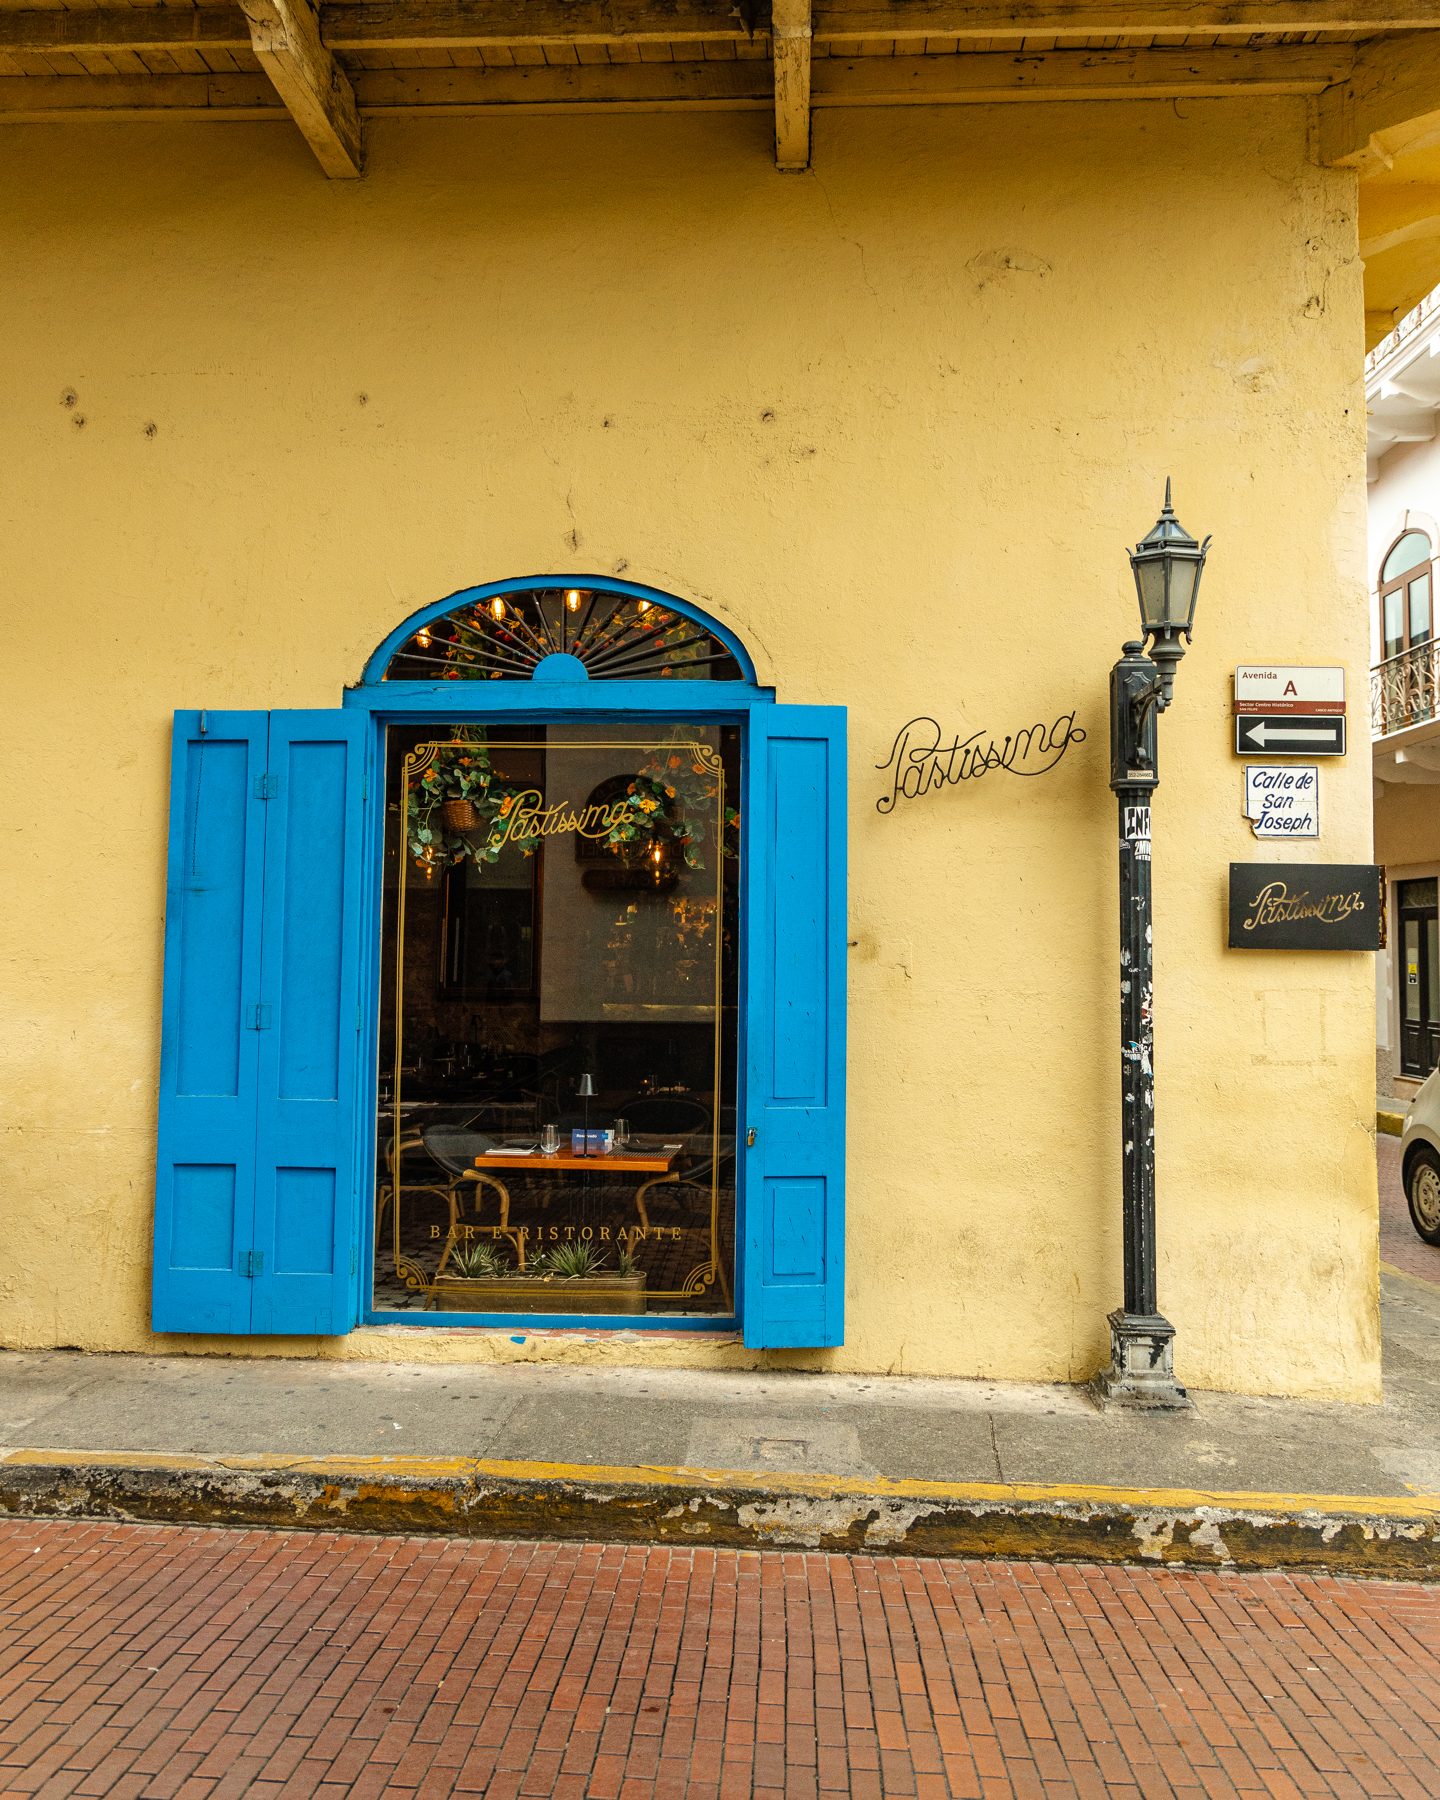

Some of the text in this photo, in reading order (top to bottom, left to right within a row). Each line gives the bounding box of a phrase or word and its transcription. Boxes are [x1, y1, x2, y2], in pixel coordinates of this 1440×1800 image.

[1242, 672, 1278, 680] Avenida
[1283, 680, 1298, 696] A
[1252, 771, 1314, 789] Calle de
[1254, 811, 1312, 833] Joseph
[430, 1225, 682, 1240] BAR E RISTORANTE
